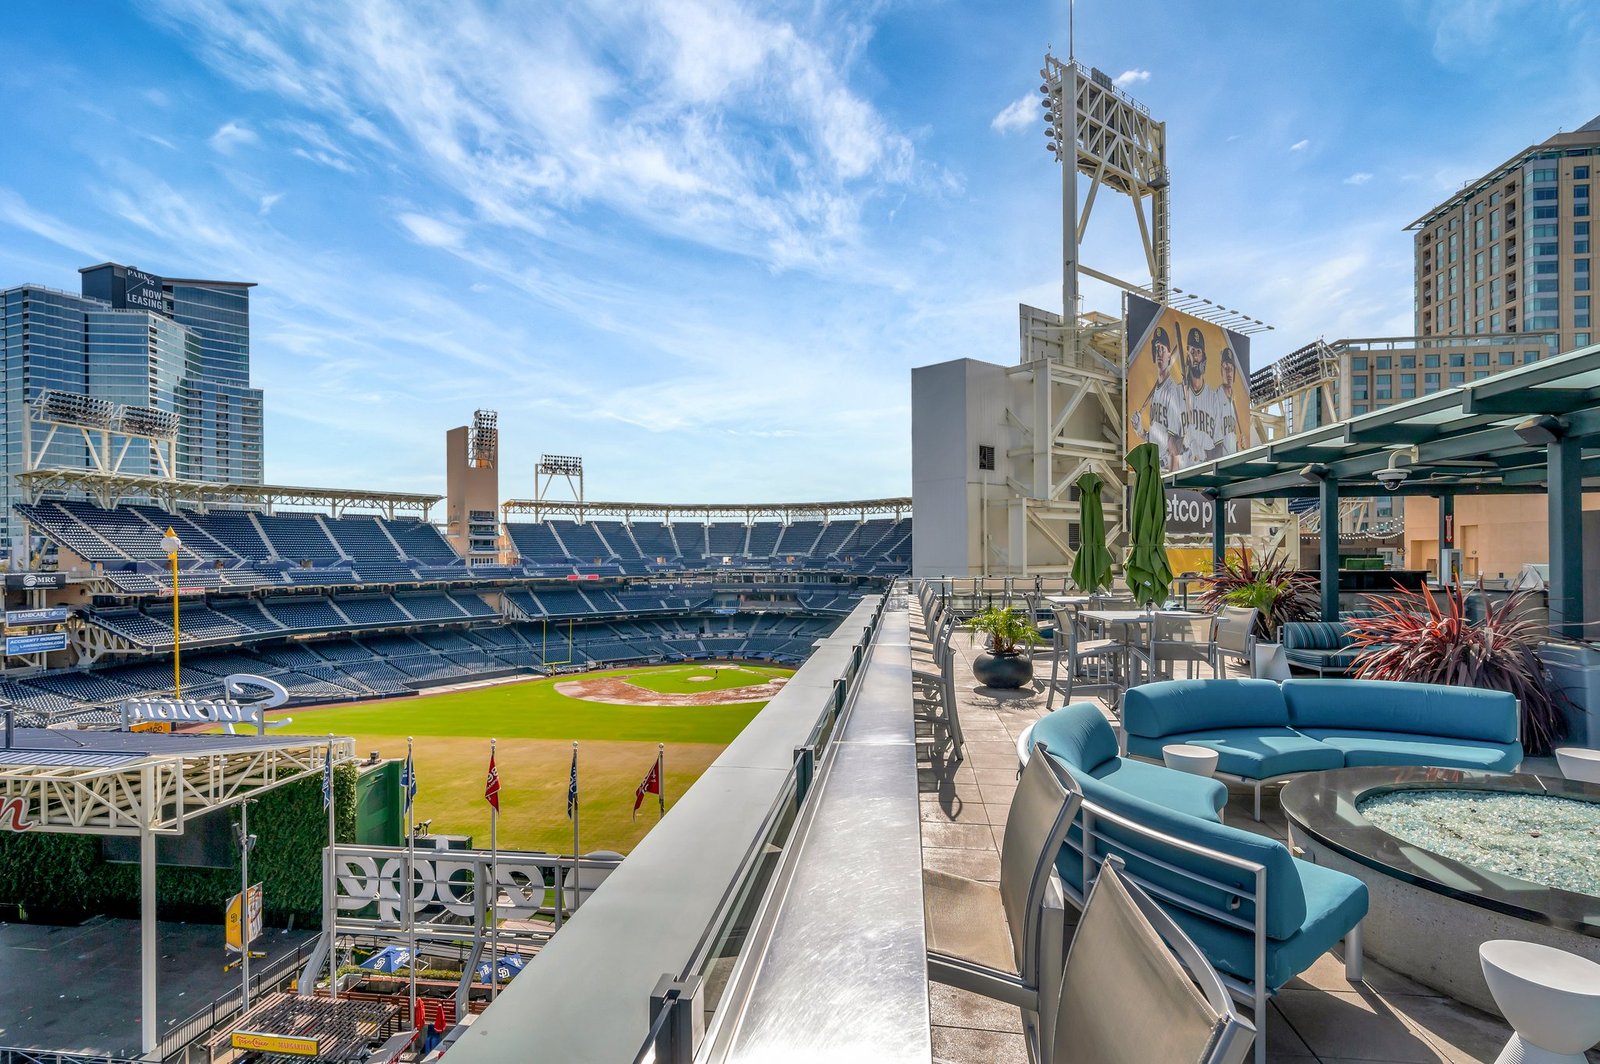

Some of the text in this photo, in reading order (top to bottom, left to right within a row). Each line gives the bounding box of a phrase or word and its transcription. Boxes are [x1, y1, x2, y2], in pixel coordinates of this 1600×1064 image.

[127, 269, 149, 281] PARK
[142, 288, 162, 300] NOW
[127, 293, 162, 310] LEASING
[1165, 494, 1237, 528] etco pk
